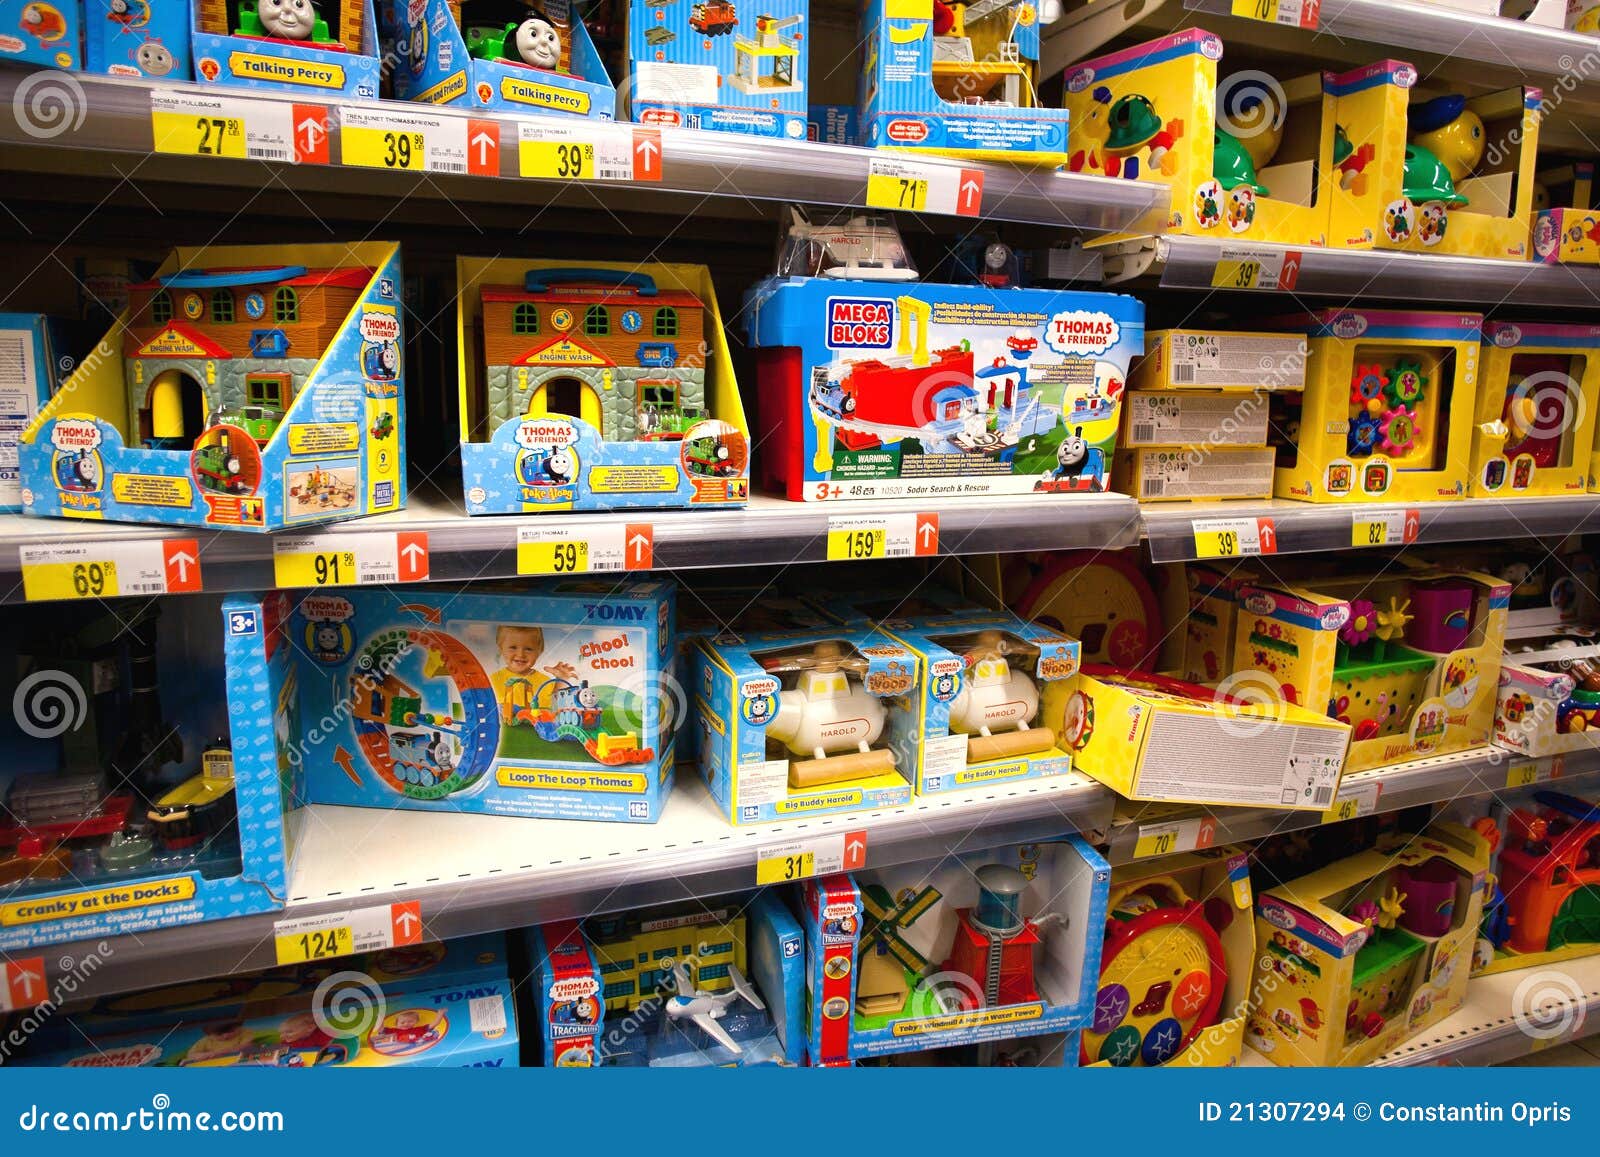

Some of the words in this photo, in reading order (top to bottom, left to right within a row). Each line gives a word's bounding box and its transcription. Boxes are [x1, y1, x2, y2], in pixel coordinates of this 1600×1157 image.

[243, 60, 295, 78] Talking
[297, 67, 333, 83] Percy
[443, 78, 464, 96] Friends
[181, 100, 222, 108] PULLBACKS
[512, 85, 552, 103] Talking
[553, 95, 581, 109] Percy
[197, 118, 226, 155] 27
[228, 119, 239, 130] 90
[384, 133, 411, 169] 39
[414, 134, 424, 145] 90
[558, 145, 582, 178] 39
[584, 146, 594, 155] 90
[899, 179, 917, 208] 71
[1235, 262, 1253, 287] 39
[381, 280, 393, 295] 3+
[833, 303, 889, 324] MEGA
[363, 318, 397, 332] THOMAS
[1054, 320, 1112, 335] THOMAS
[372, 330, 395, 339] FRIENDS
[832, 322, 889, 345] BLOKS
[1067, 335, 1107, 345] FRIENDS
[150, 344, 174, 352] ENGINE
[174, 344, 195, 352] WASH
[539, 354, 567, 362] ENGINE
[568, 353, 593, 362] WASH
[56, 426, 97, 439] THOMAS
[522, 426, 572, 436] THOMAS
[65, 438, 94, 447] FRIENDS
[534, 436, 568, 444] FRIENDS
[380, 453, 386, 464] 9
[857, 454, 892, 463] WARNING:
[857, 464, 876, 472] HAZARD
[522, 488, 545, 500] Take
[548, 489, 573, 500] Along
[815, 482, 844, 500] 3+
[849, 485, 862, 496] 48
[906, 486, 928, 494] Sodor
[930, 485, 955, 494] Search
[956, 484, 962, 492] &
[964, 484, 990, 492] Rescue
[1369, 522, 1382, 544] 82
[846, 531, 874, 558] 159
[1218, 532, 1233, 555] 39
[554, 543, 576, 572] 59
[579, 542, 588, 551] 90
[314, 554, 340, 585] 91
[344, 553, 354, 563] 90
[72, 563, 105, 596] 69
[305, 601, 349, 611] THOMAS
[583, 604, 648, 621] TOMY
[231, 615, 254, 632] 3+
[579, 633, 630, 657] Choo!
[590, 655, 634, 670] Choo!
[934, 662, 960, 671] THOMAS
[1041, 664, 1073, 675] WOOD
[745, 681, 775, 691] THOMAS
[869, 679, 909, 691] WOOD
[984, 708, 1017, 720] HAROLD
[820, 726, 858, 739] HAROLD
[976, 770, 997, 780] Buddy
[998, 765, 1021, 774] Harold
[509, 773, 536, 784] Loop
[538, 774, 559, 784] The
[560, 775, 587, 786] Loop
[588, 776, 634, 788] Thomas
[785, 800, 799, 811] Big
[799, 797, 825, 809] Buddy
[827, 794, 853, 805] Harold
[1338, 801, 1351, 819] 46
[1153, 835, 1169, 855] 70
[785, 855, 803, 880] 31
[15, 899, 79, 919] Cranky
[81, 894, 101, 909] at
[102, 889, 130, 907] the
[133, 883, 181, 902] Docks
[826, 905, 855, 915] THOMAS
[62, 919, 98, 931] Docks
[105, 911, 145, 925] Cranky
[120, 917, 159, 932] Cranky
[299, 930, 339, 960] 124
[785, 941, 800, 957] 3+
[554, 981, 595, 993] THOMAS
[562, 987, 592, 997] FRIENDS
[430, 985, 499, 1005] TOMY
